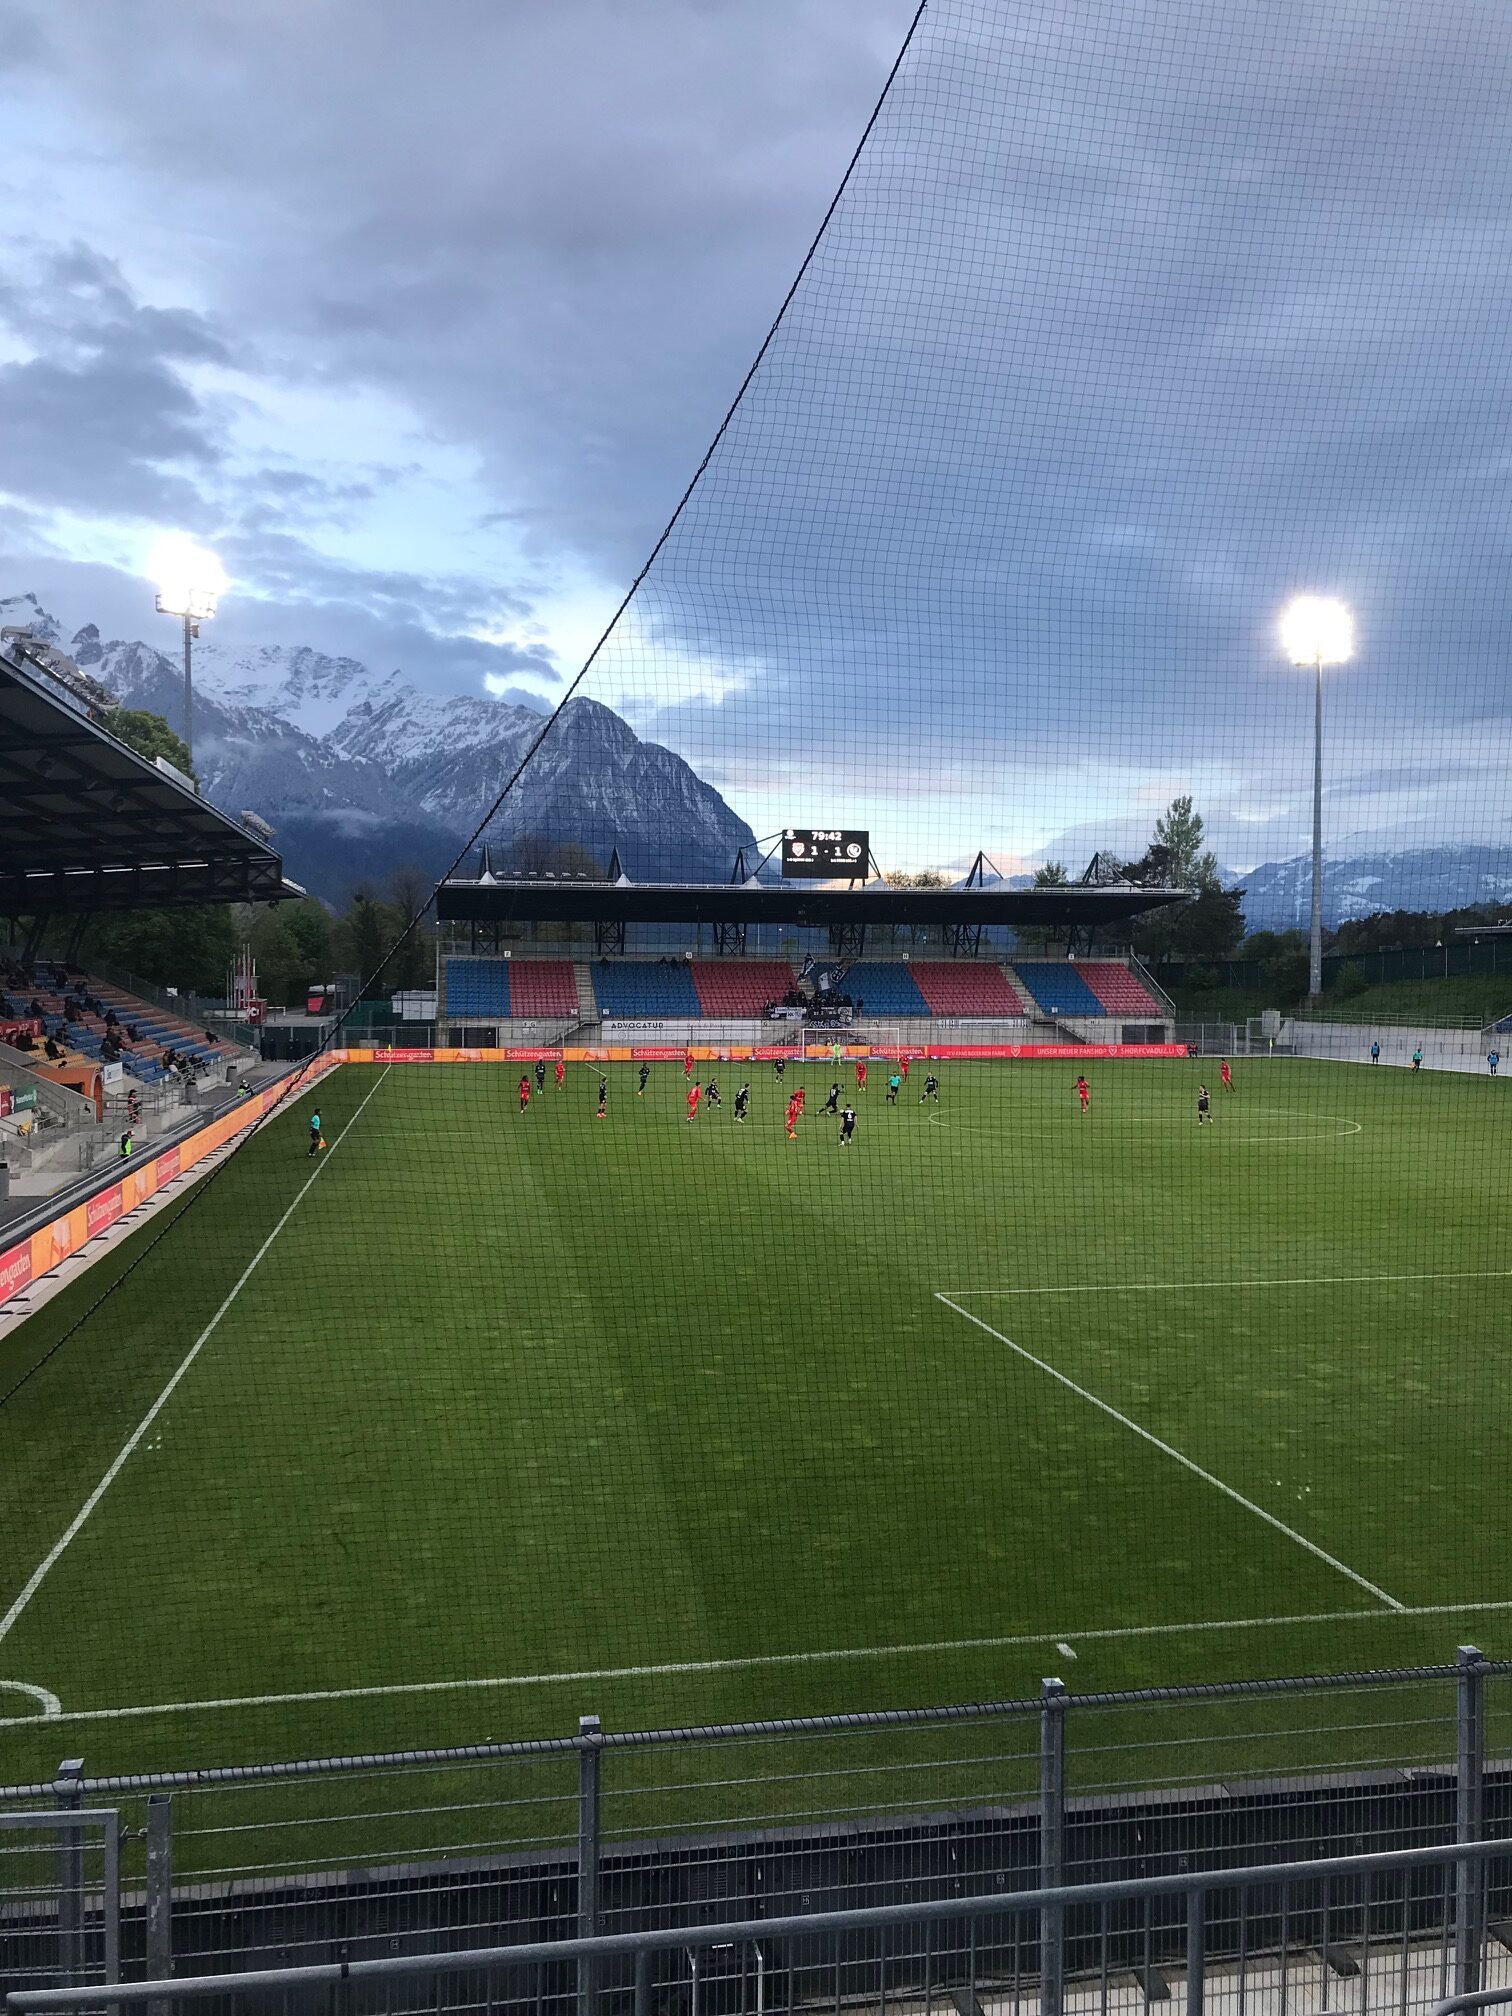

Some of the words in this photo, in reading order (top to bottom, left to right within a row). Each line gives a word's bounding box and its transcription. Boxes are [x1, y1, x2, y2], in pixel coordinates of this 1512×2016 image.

[812, 832, 842, 841] 79:42
[810, 846, 818, 855] 1
[834, 846, 842, 856] 1
[507, 1050, 561, 1059] Schützengarten
[633, 1049, 686, 1058] Schützengarten
